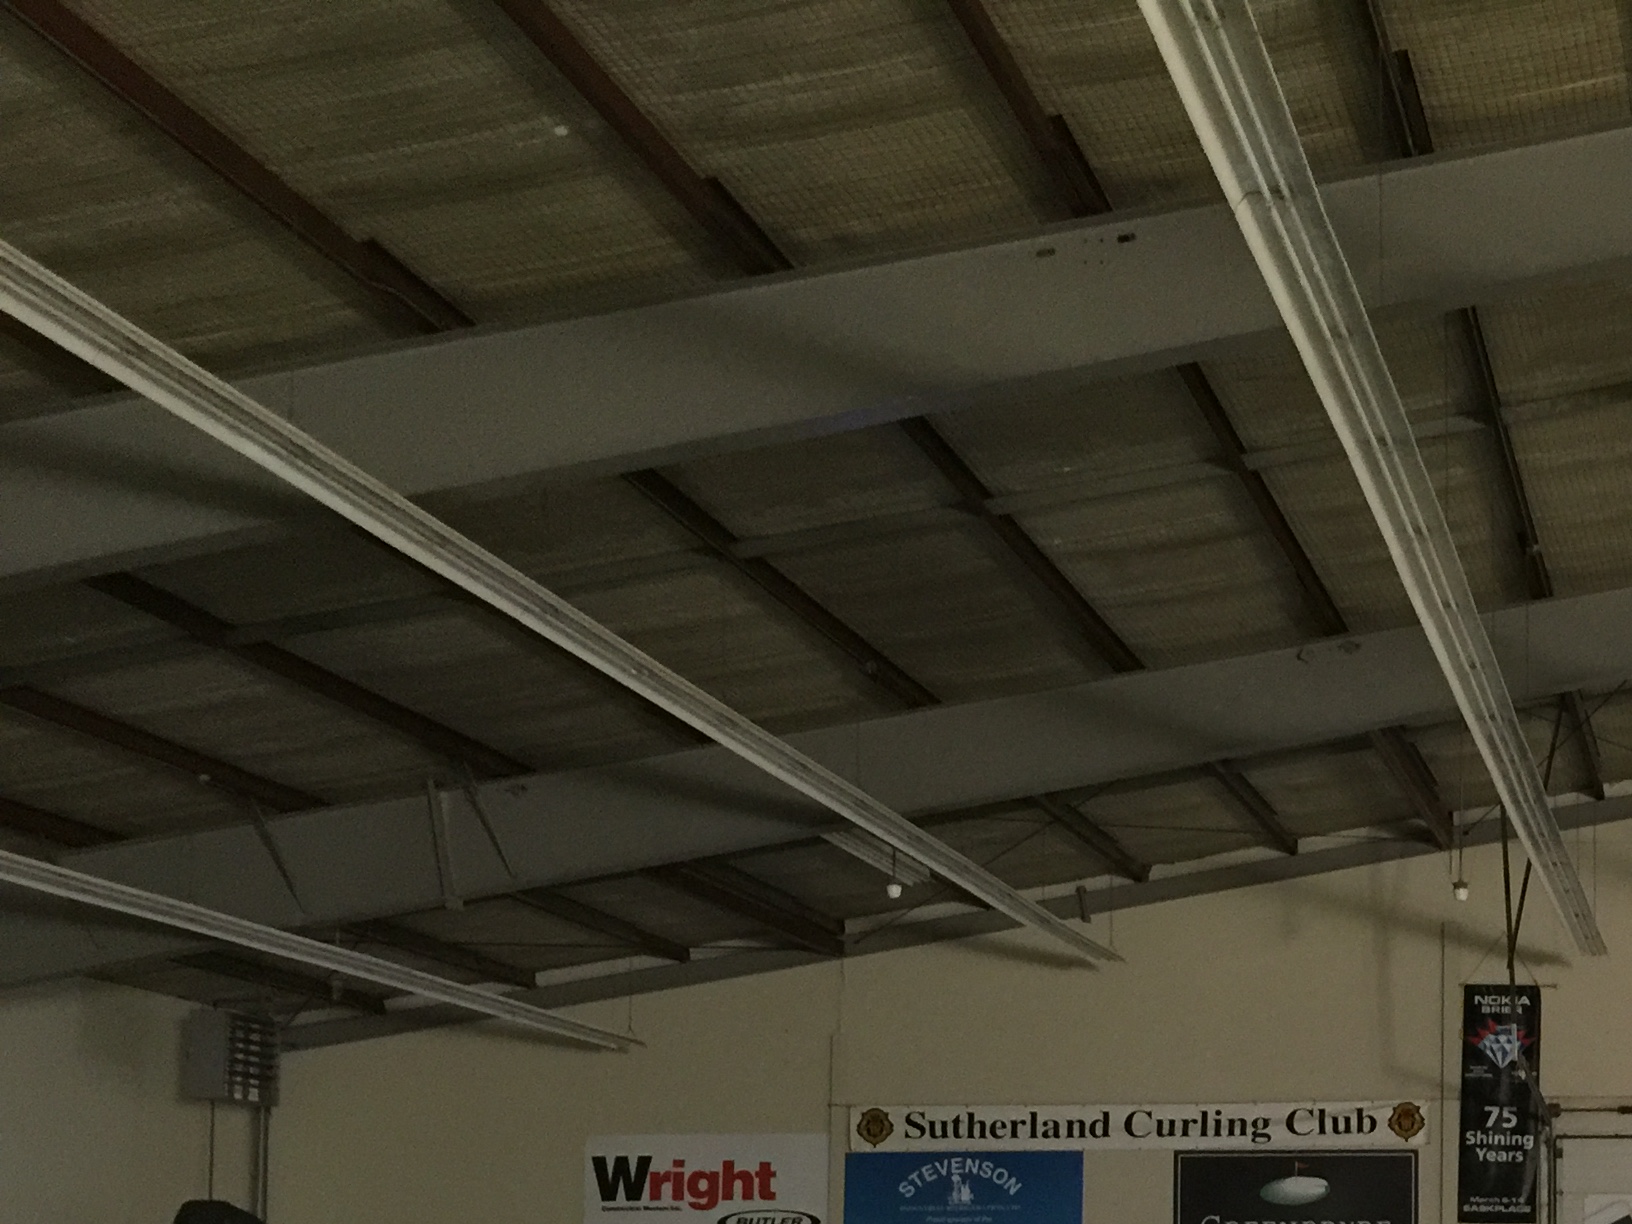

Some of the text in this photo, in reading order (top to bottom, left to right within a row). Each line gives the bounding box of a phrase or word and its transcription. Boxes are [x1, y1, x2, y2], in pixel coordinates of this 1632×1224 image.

[1474, 995, 1531, 1006] NOKIA
[904, 1107, 1378, 1143] Sutherland Curling Club
[1484, 1106, 1518, 1128] 75
[1465, 1130, 1534, 1150] Shining
[1475, 1149, 1524, 1163] Years
[592, 1156, 777, 1211] Wright
[898, 1157, 1023, 1199] STEVENSON
